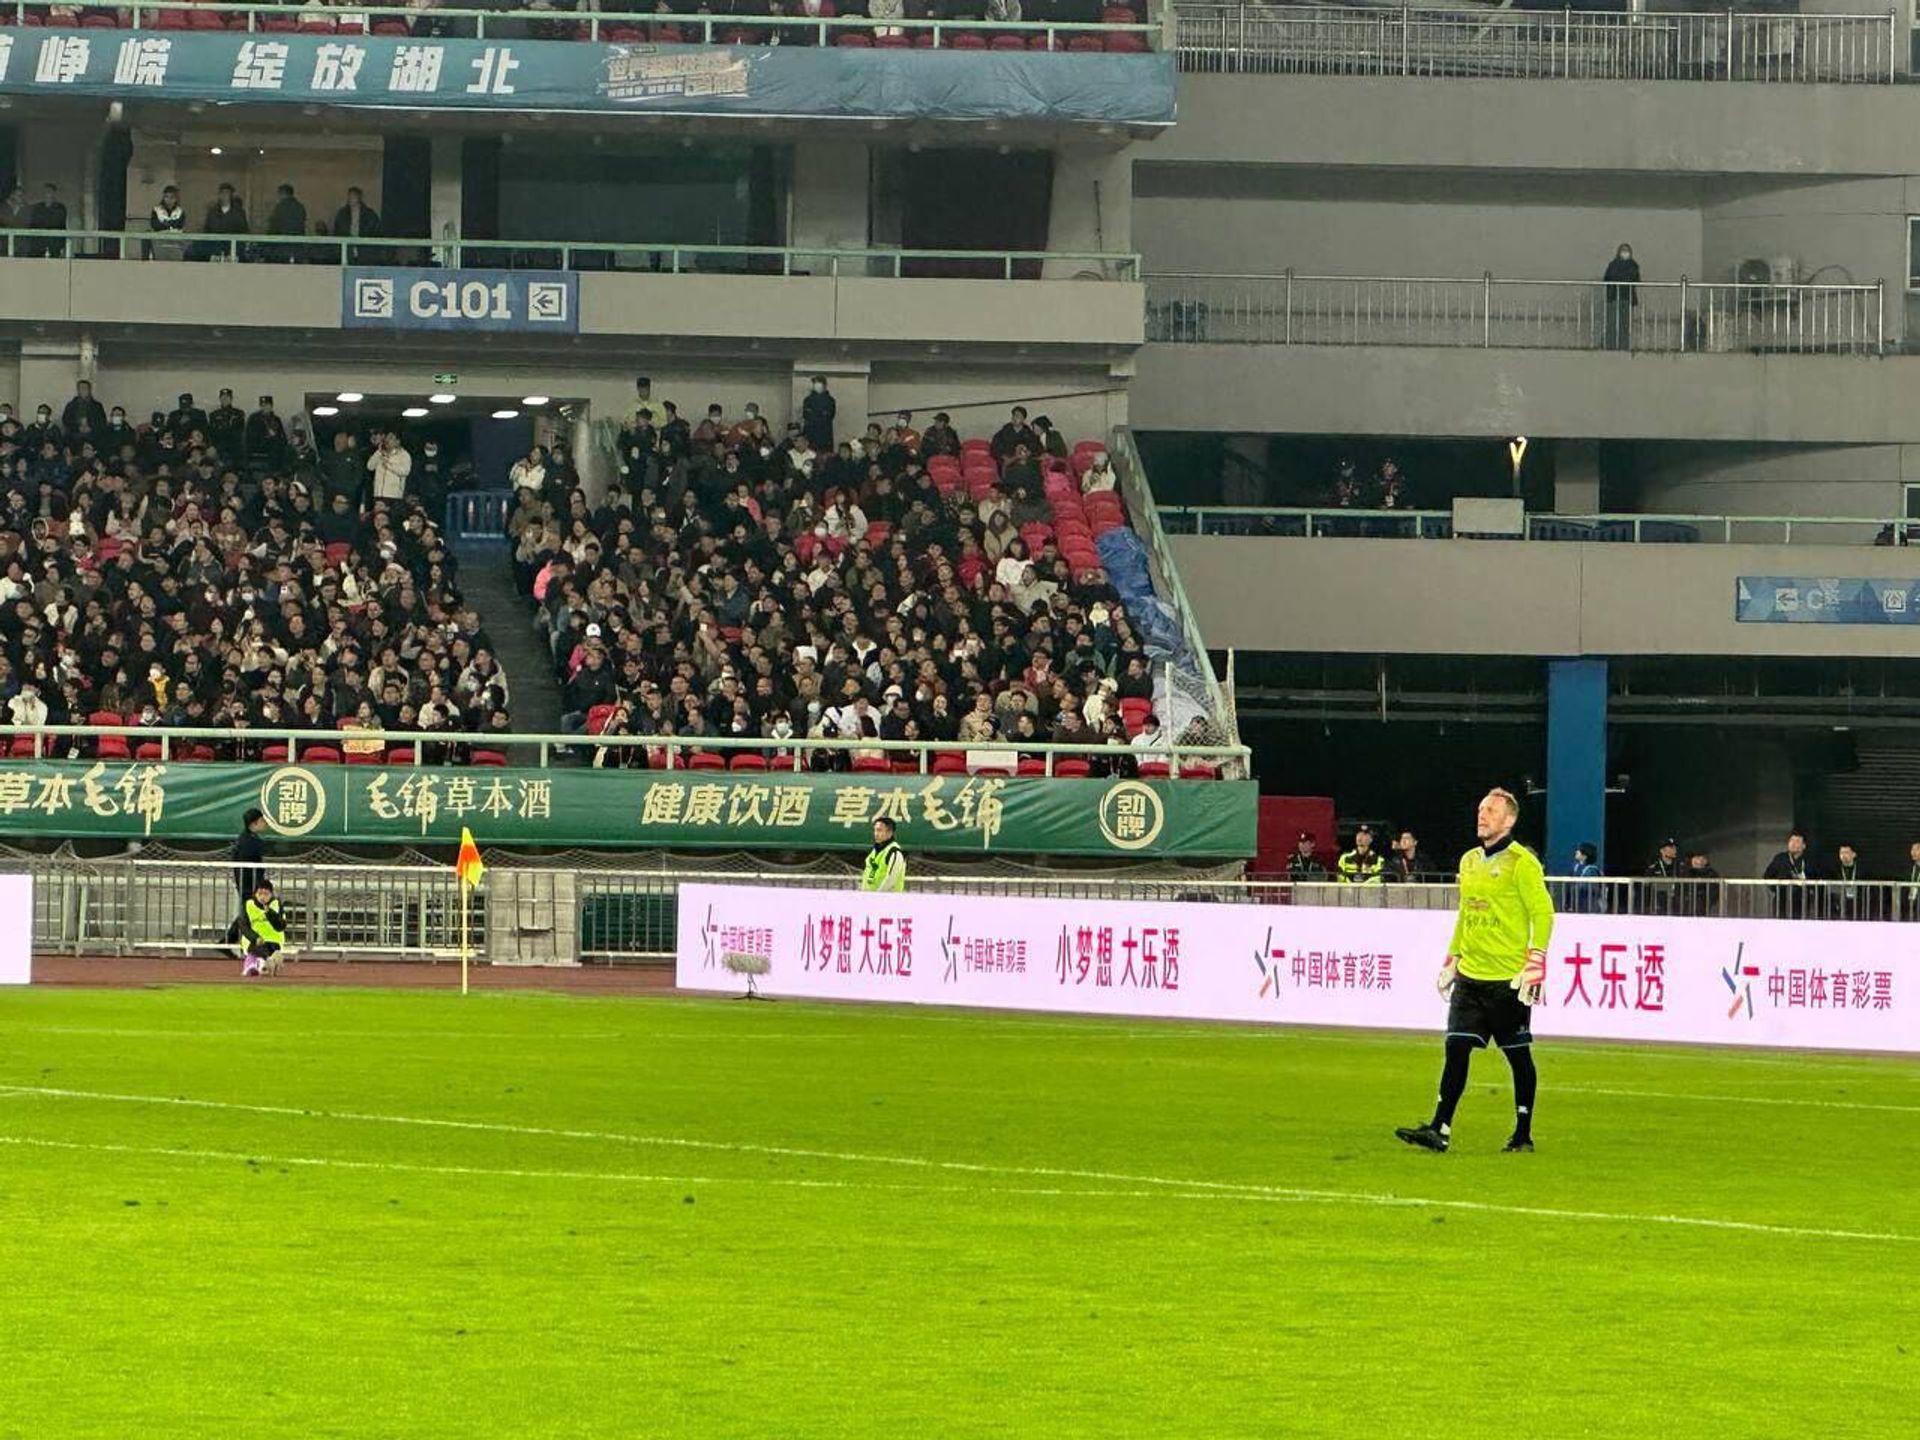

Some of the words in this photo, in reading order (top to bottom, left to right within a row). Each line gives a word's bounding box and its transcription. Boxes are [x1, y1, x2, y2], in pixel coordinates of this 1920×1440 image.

[231, 41, 520, 94] 绽放湖北
[409, 280, 512, 319] C101
[641, 782, 814, 826] 健康饮酒
[801, 912, 852, 974] 小梦想
[858, 914, 913, 977] 大乐透
[964, 937, 1027, 973] 中国体育彩票
[1056, 925, 1113, 987] 小梦想
[1121, 927, 1180, 990] 大乐透
[1291, 949, 1393, 990] 中国体育彩票
[1563, 942, 1665, 1011] 大乐透
[1768, 967, 1893, 1010] 中国体育彩票
